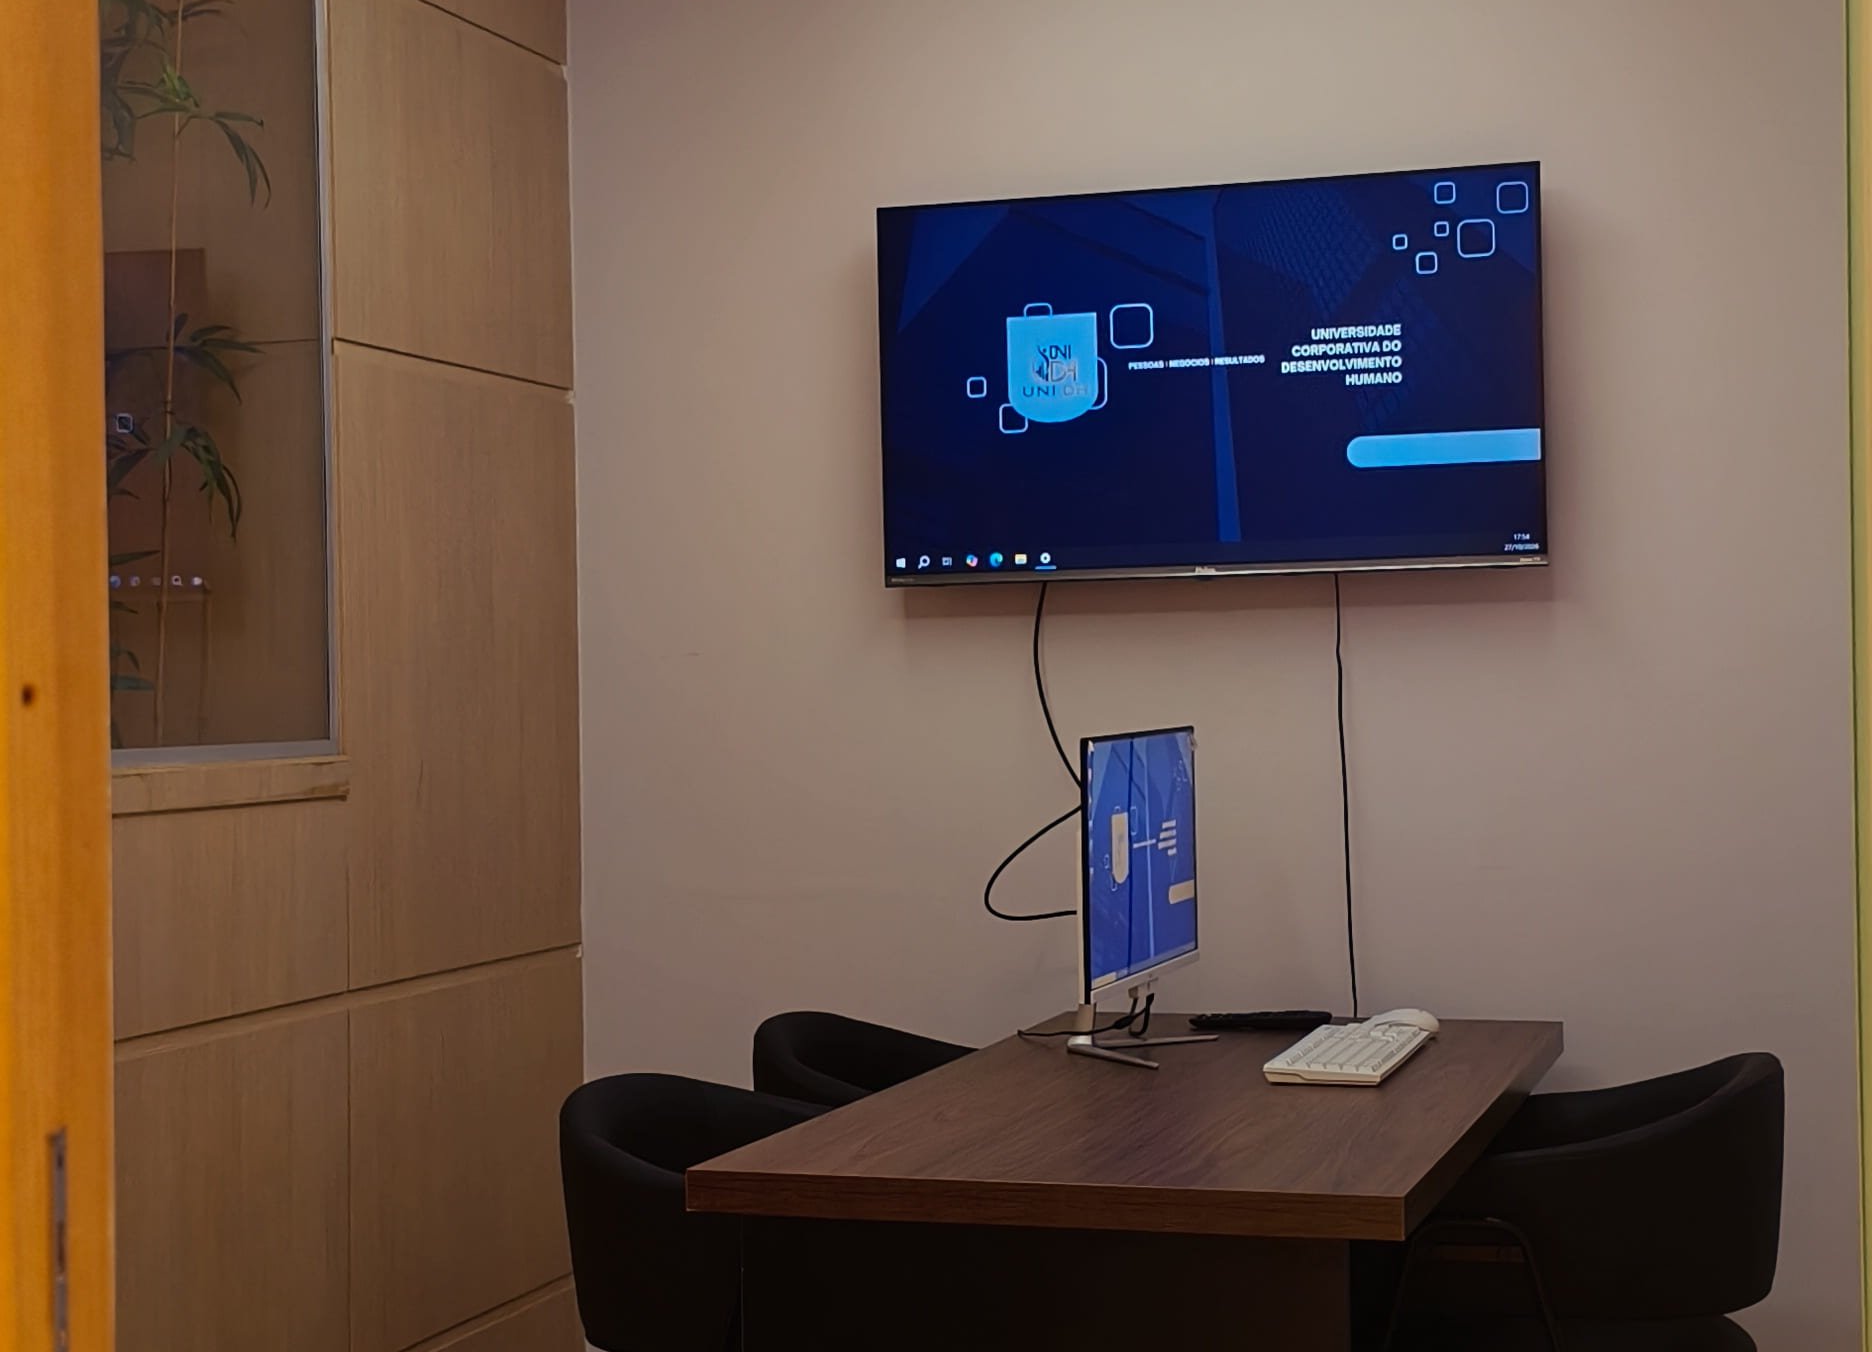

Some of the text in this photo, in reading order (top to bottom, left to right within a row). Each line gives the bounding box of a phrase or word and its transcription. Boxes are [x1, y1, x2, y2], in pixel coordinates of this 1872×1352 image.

[1311, 324, 1402, 340] UNIVERSIDADE
[1291, 340, 1402, 357] CORPORATIVA DO
[1128, 360, 1164, 370] PESSOAS
[1214, 354, 1265, 366] RESULTADOS
[1281, 355, 1402, 374] DESENVOLVIMENTO
[1345, 371, 1402, 386] HUMANO
[1022, 384, 1056, 398] UNI
